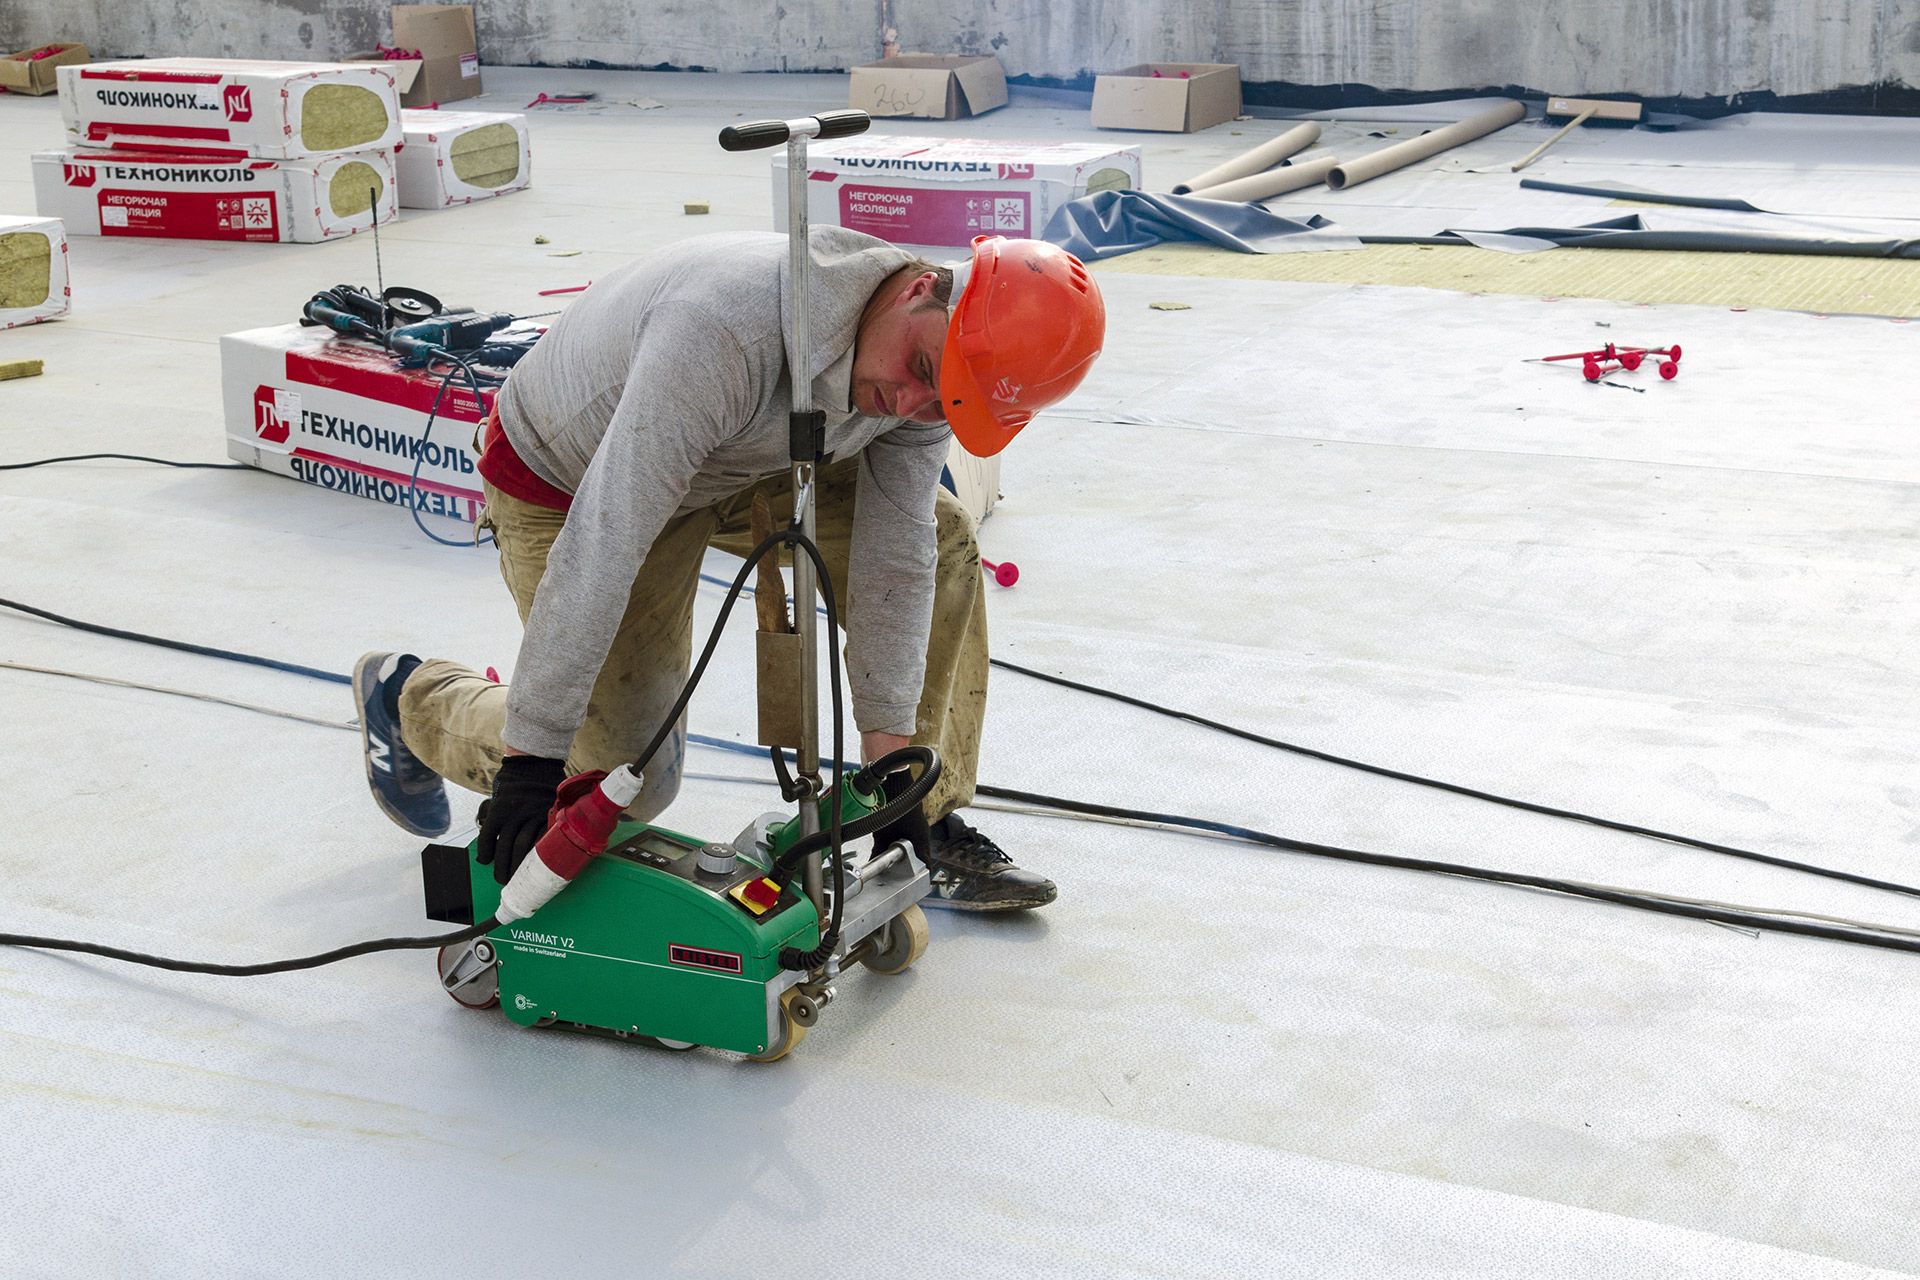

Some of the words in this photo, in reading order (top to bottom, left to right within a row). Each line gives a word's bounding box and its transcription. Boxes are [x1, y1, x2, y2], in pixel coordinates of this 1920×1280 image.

[96, 90, 219, 110] ХНОНИКОЛЬ
[107, 195, 168, 206] НЕГОРЮЧАЯ
[849, 191, 913, 204] НЕГОРЮЧАЯ
[127, 207, 162, 218] ЛЯЦИЯ
[850, 203, 906, 216] ИЗОЛЯЦИЯ
[290, 457, 462, 519] ТЕХНОНИКОЛЬ
[510, 928, 558, 946] VARIMAT
[560, 936, 575, 949] V2
[535, 947, 567, 959] Switzerland
[672, 948, 738, 968] LEISTER
